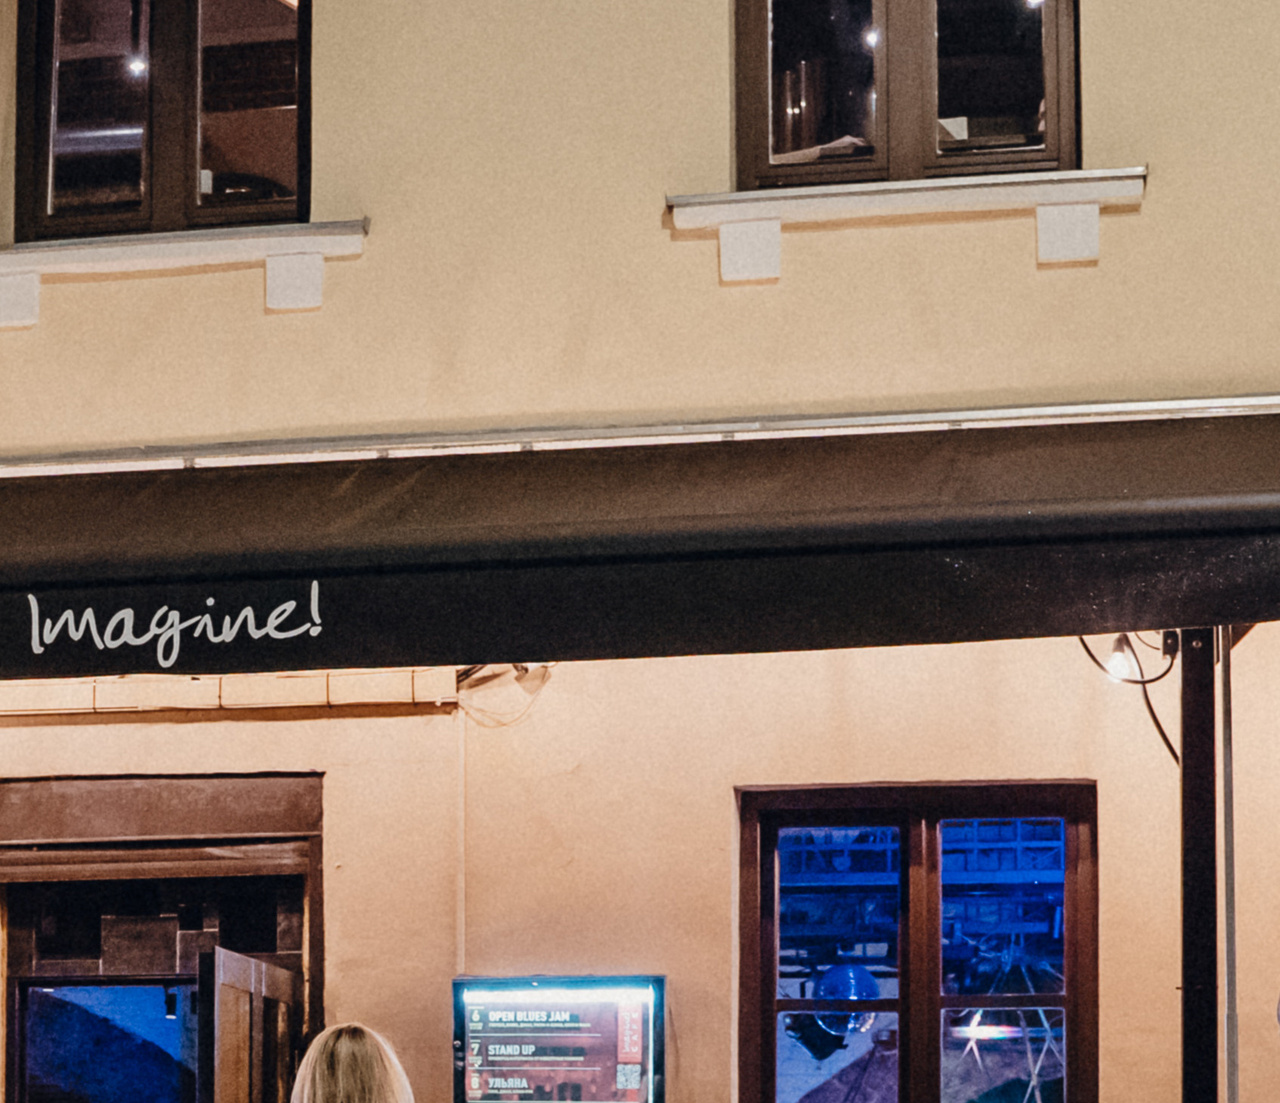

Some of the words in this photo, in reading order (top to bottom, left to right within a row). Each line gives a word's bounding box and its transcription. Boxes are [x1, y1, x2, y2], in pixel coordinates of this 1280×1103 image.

[27, 579, 322, 668] Imagine!
[472, 1010, 480, 1021] 6
[489, 1011, 515, 1022] OPEN
[516, 1011, 547, 1022] BLUES
[549, 1011, 570, 1022] JAM
[471, 1043, 480, 1055] 7
[488, 1045, 520, 1056] STAND
[521, 1045, 535, 1056] UP
[471, 1077, 480, 1089] 8
[488, 1078, 529, 1089] УЛЬЯНА
